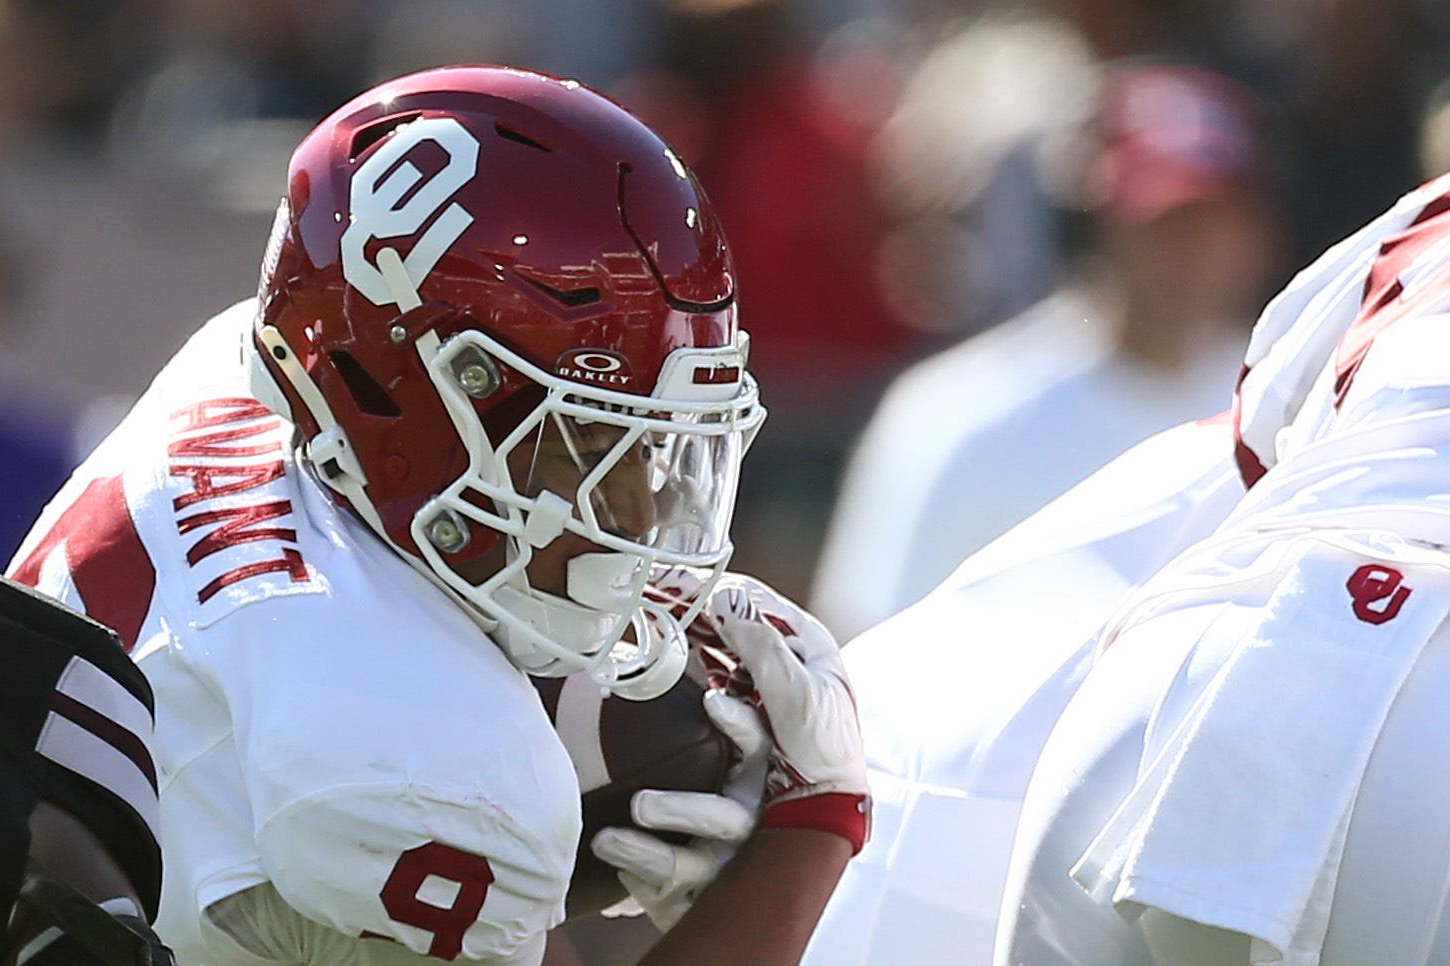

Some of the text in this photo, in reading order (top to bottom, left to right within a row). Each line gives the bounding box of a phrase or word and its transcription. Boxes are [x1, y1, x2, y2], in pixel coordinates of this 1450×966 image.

[558, 367, 632, 385] OAKLEY
[167, 397, 312, 606] AVANT
[358, 841, 496, 962] 9
